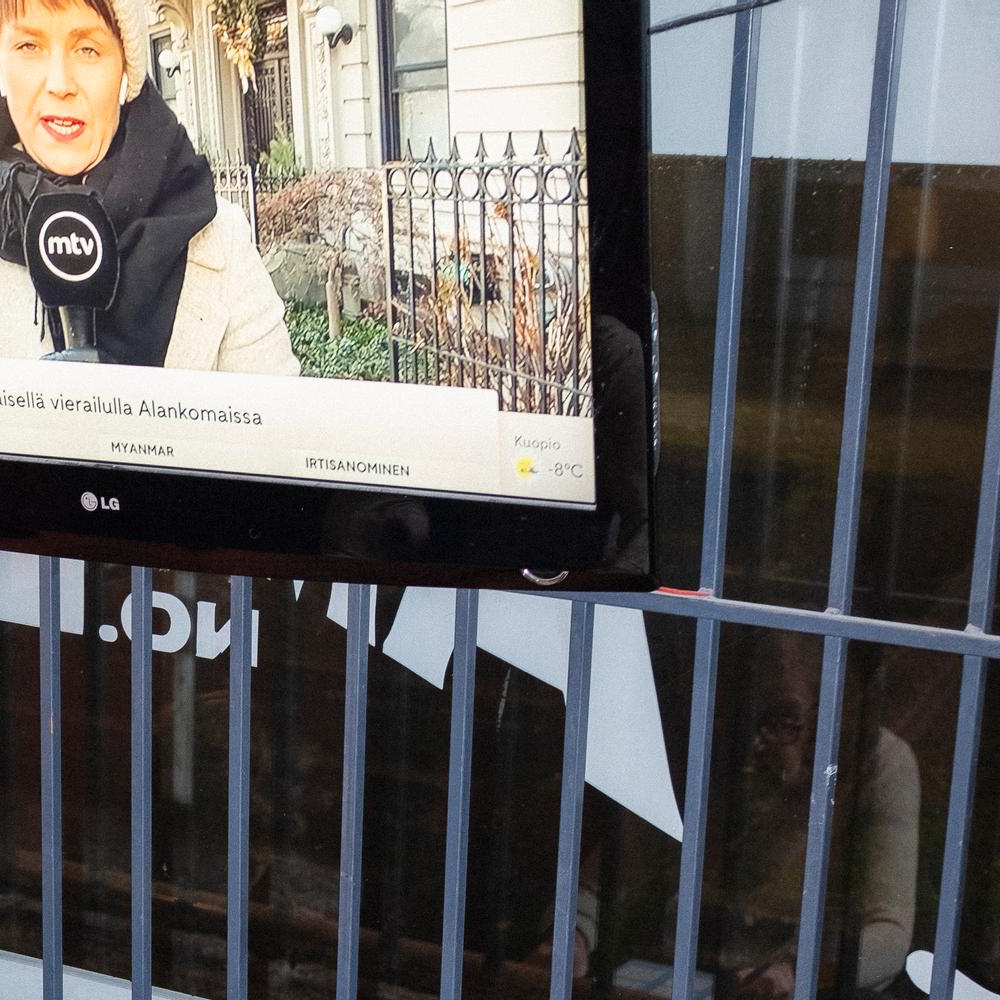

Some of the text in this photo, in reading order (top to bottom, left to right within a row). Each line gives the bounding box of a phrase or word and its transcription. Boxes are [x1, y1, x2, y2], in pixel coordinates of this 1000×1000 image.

[48, 232, 94, 255] mtv
[50, 394, 132, 416] vierailulla
[139, 400, 262, 425] Alankomaissa
[111, 442, 174, 457] MYANMAR
[514, 435, 561, 451] Kuopio
[305, 457, 410, 477] IRTISANOMINEN
[548, 462, 584, 478] -8°C
[100, 496, 120, 510] LG
